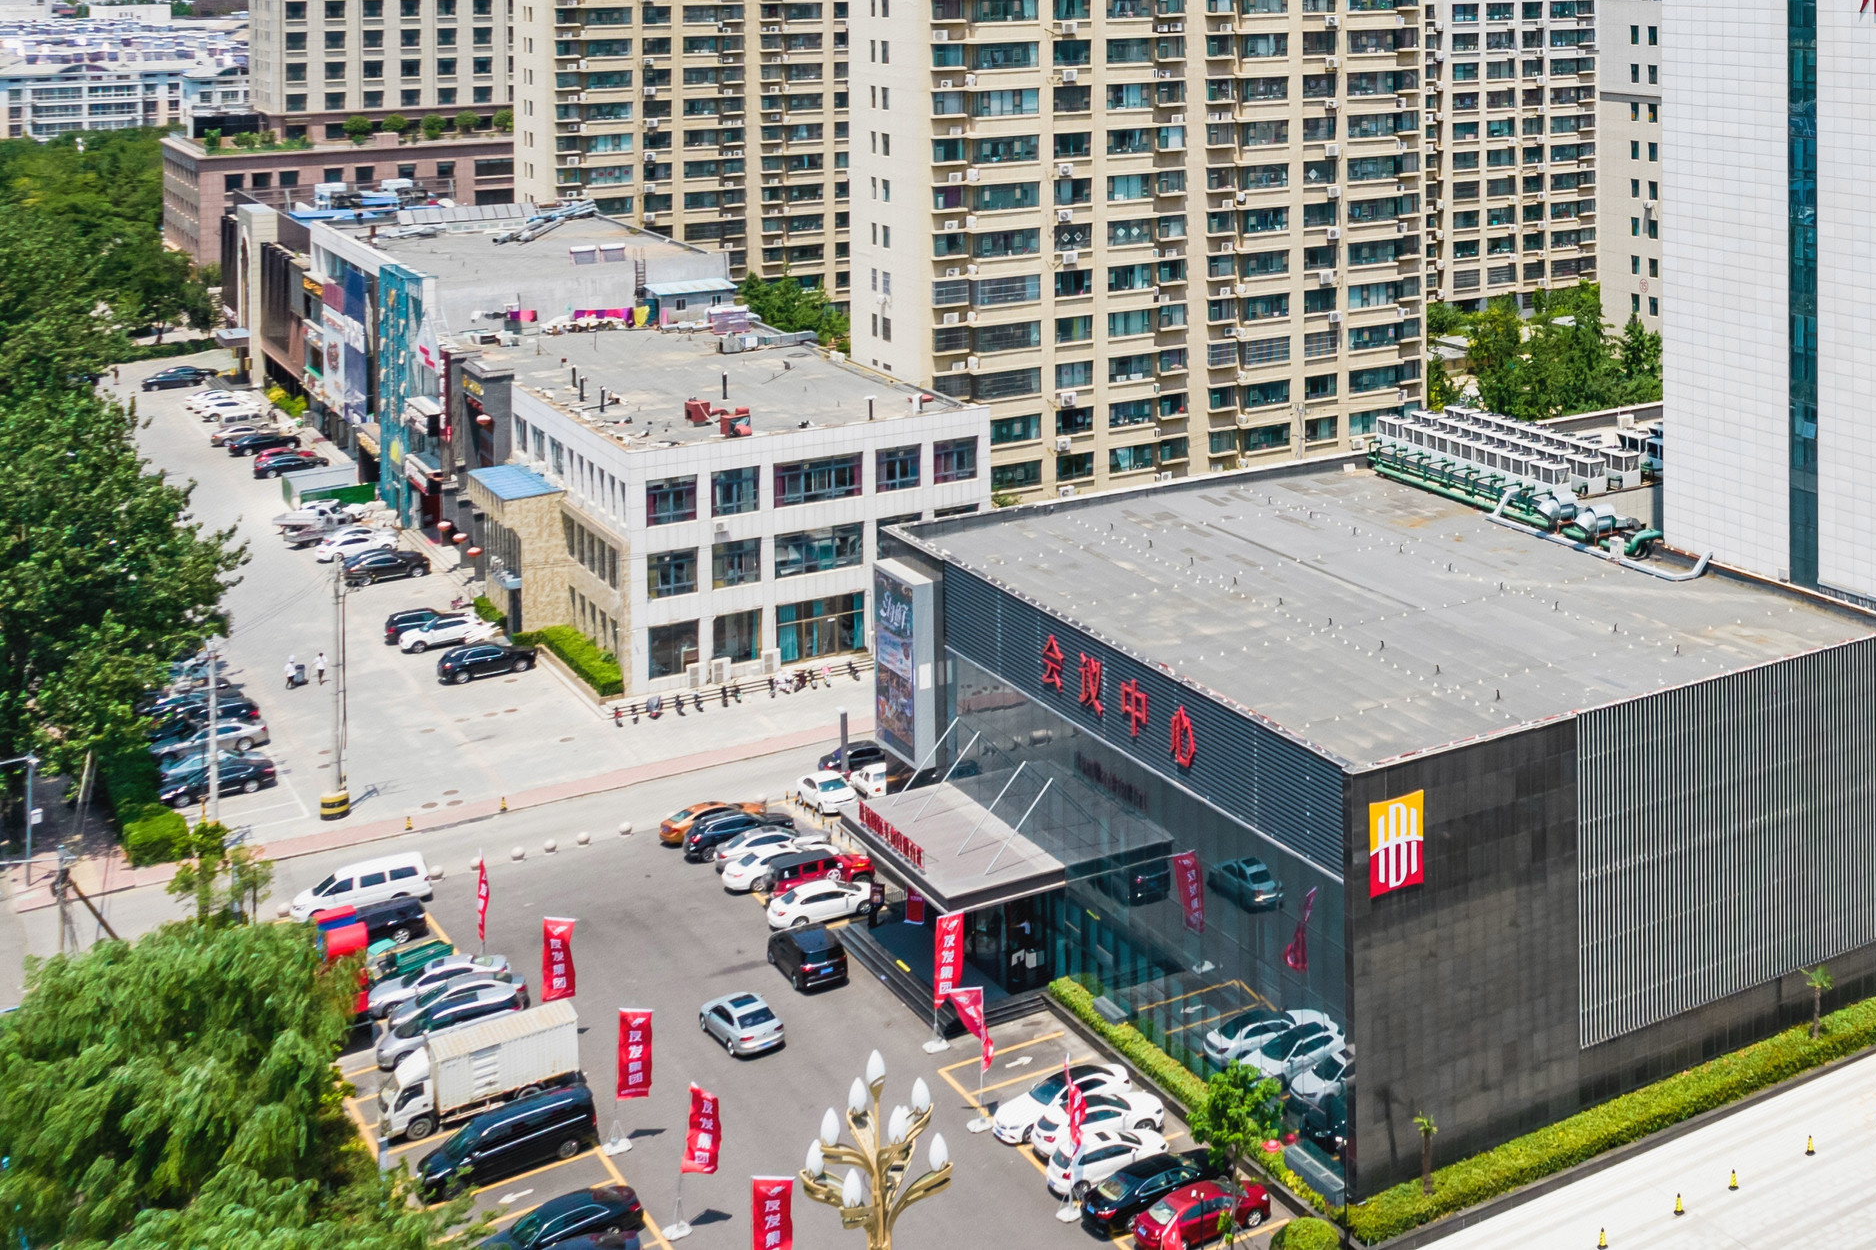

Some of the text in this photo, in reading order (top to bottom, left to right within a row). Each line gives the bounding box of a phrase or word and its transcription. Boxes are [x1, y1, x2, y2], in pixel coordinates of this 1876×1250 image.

[1042, 634, 1196, 768] 会议中心
[764, 1199, 781, 1250] 友发集
